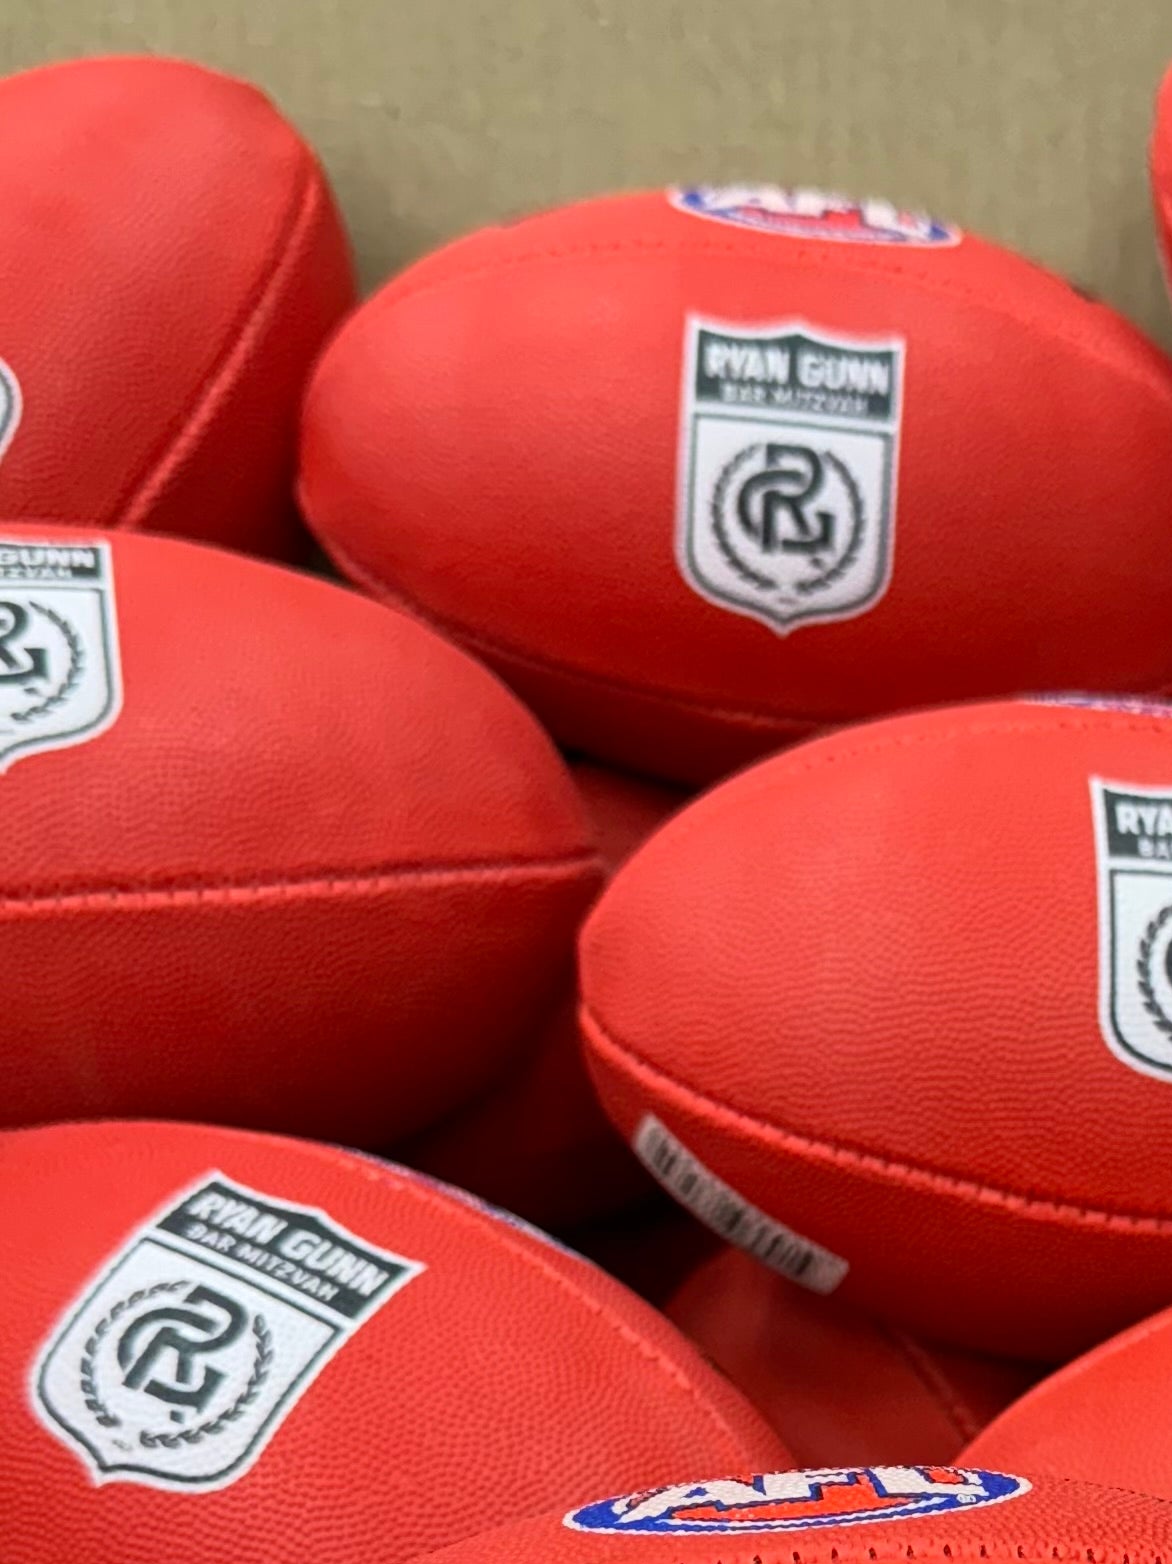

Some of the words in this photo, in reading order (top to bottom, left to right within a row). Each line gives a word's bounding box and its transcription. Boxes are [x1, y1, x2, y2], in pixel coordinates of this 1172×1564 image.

[704, 342, 790, 383] RYAN
[799, 355, 888, 395] GUNN
[184, 1223, 235, 1256] BAR
[235, 1245, 340, 1303] MITZVAH
[187, 1192, 288, 1247] RYAN
[279, 1229, 389, 1298] GUNN
[611, 1465, 989, 1524] AFL
